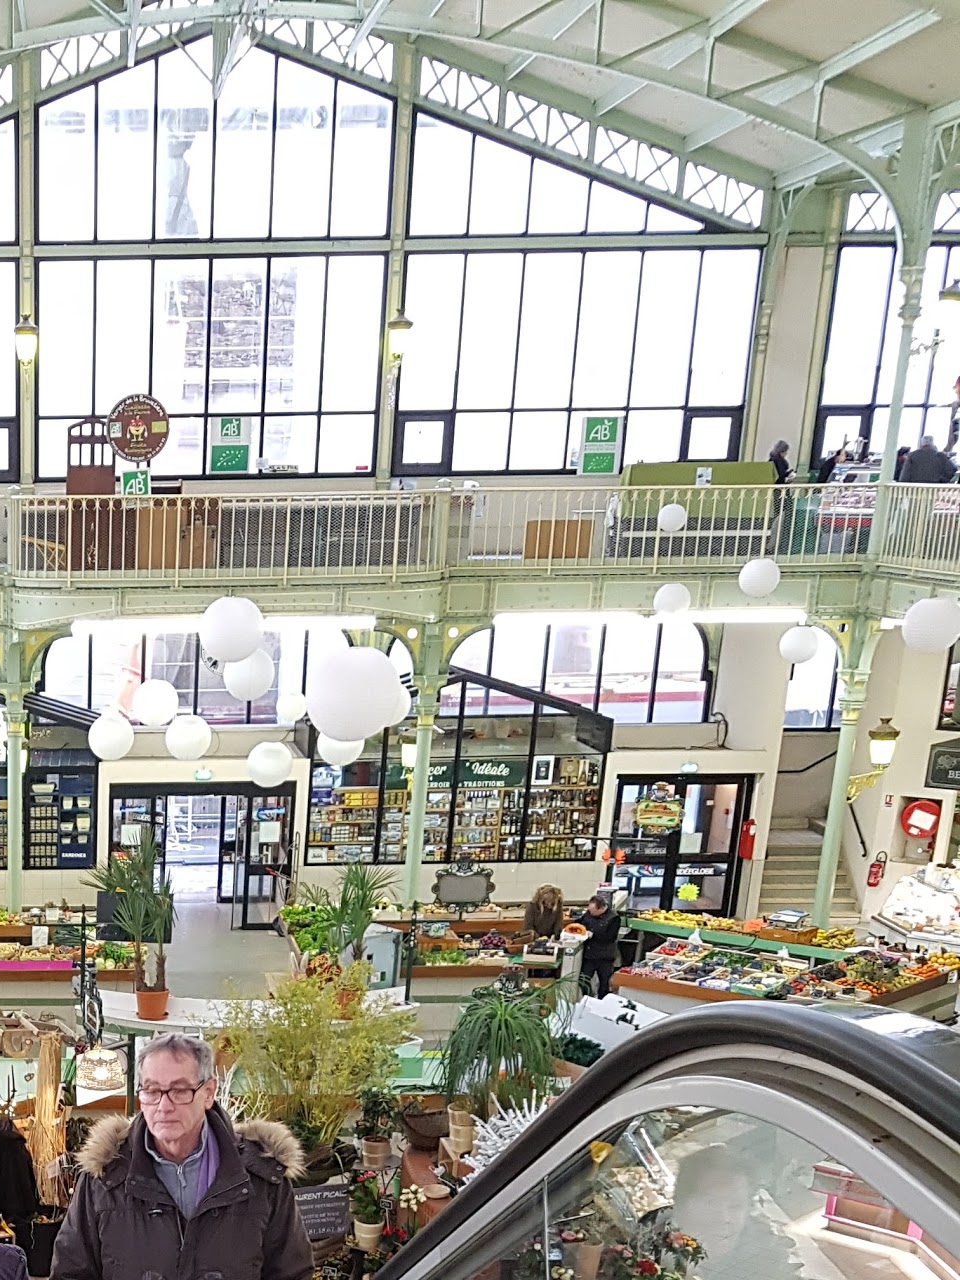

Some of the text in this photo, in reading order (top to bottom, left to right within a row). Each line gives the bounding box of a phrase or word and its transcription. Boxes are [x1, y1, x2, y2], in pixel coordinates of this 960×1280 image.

[221, 423, 239, 436] AB
[589, 424, 611, 441] AB
[125, 478, 145, 495] AB
[463, 780, 505, 788] TRADITIONS
[294, 1193, 322, 1201] AURENT
